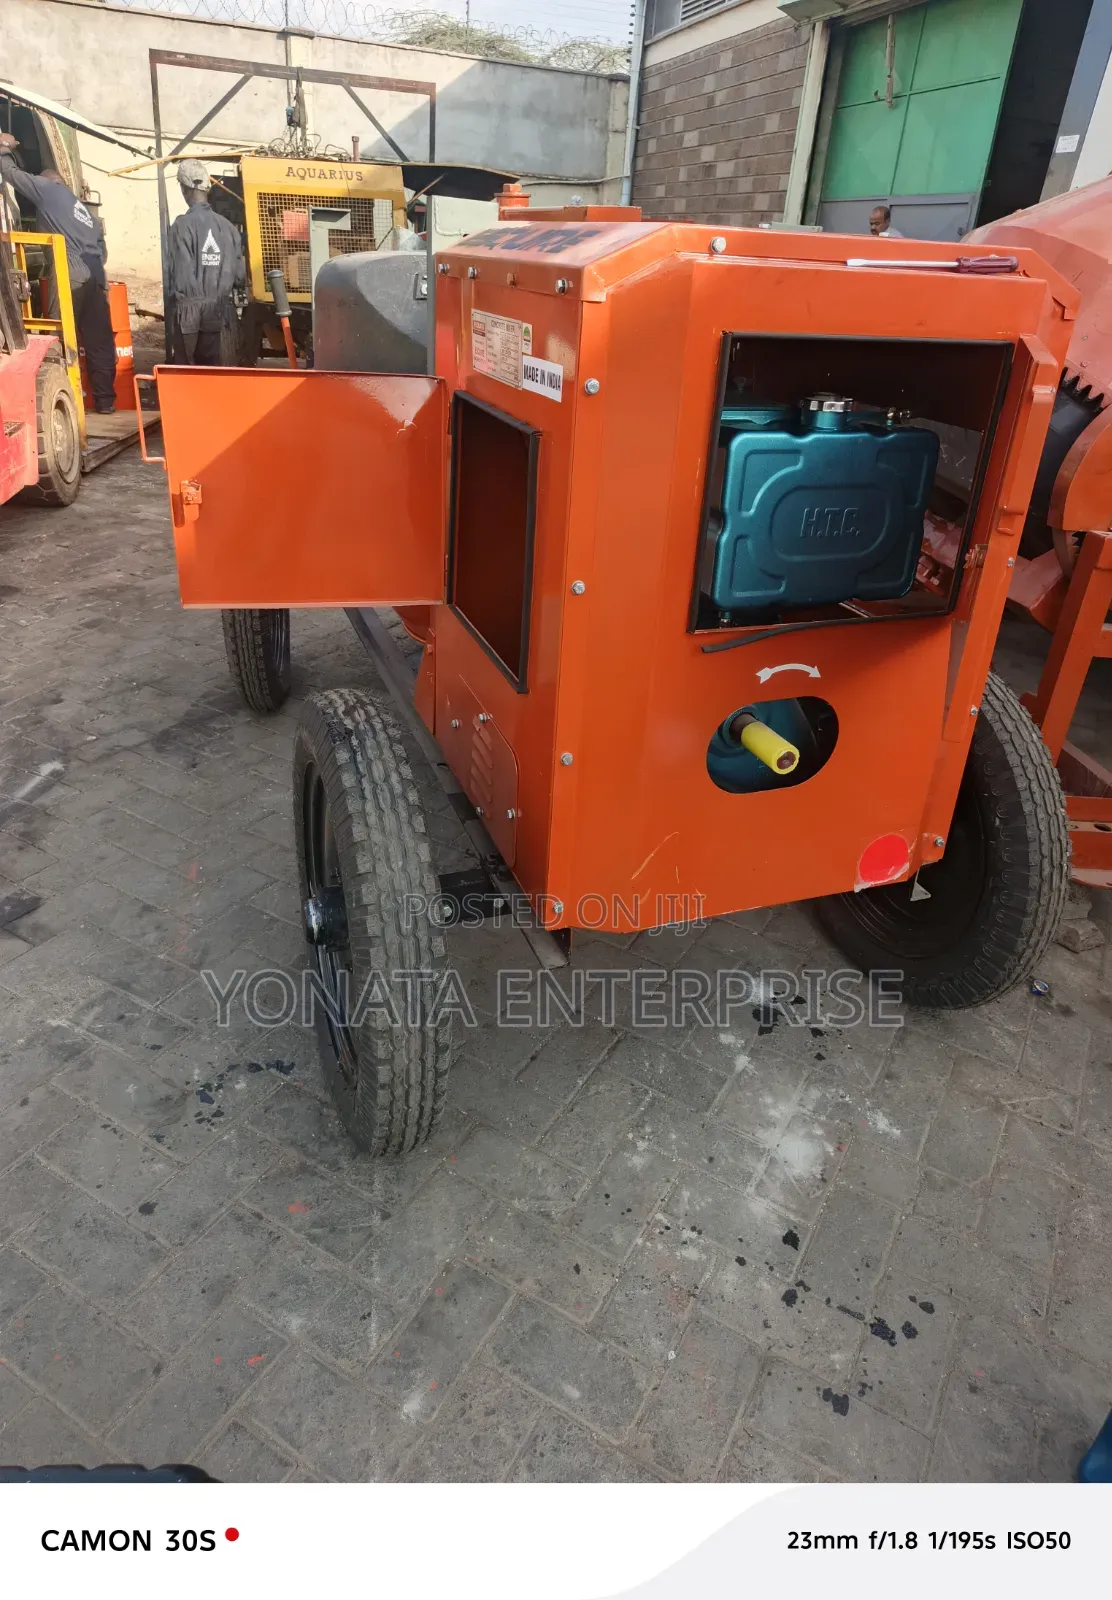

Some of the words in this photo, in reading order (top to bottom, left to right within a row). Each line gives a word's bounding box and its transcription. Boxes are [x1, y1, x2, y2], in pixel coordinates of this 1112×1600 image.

[285, 166, 363, 181] AQUARIUS
[523, 364, 539, 383] MADE
[539, 368, 546, 386] IN
[546, 371, 562, 391] INDIA
